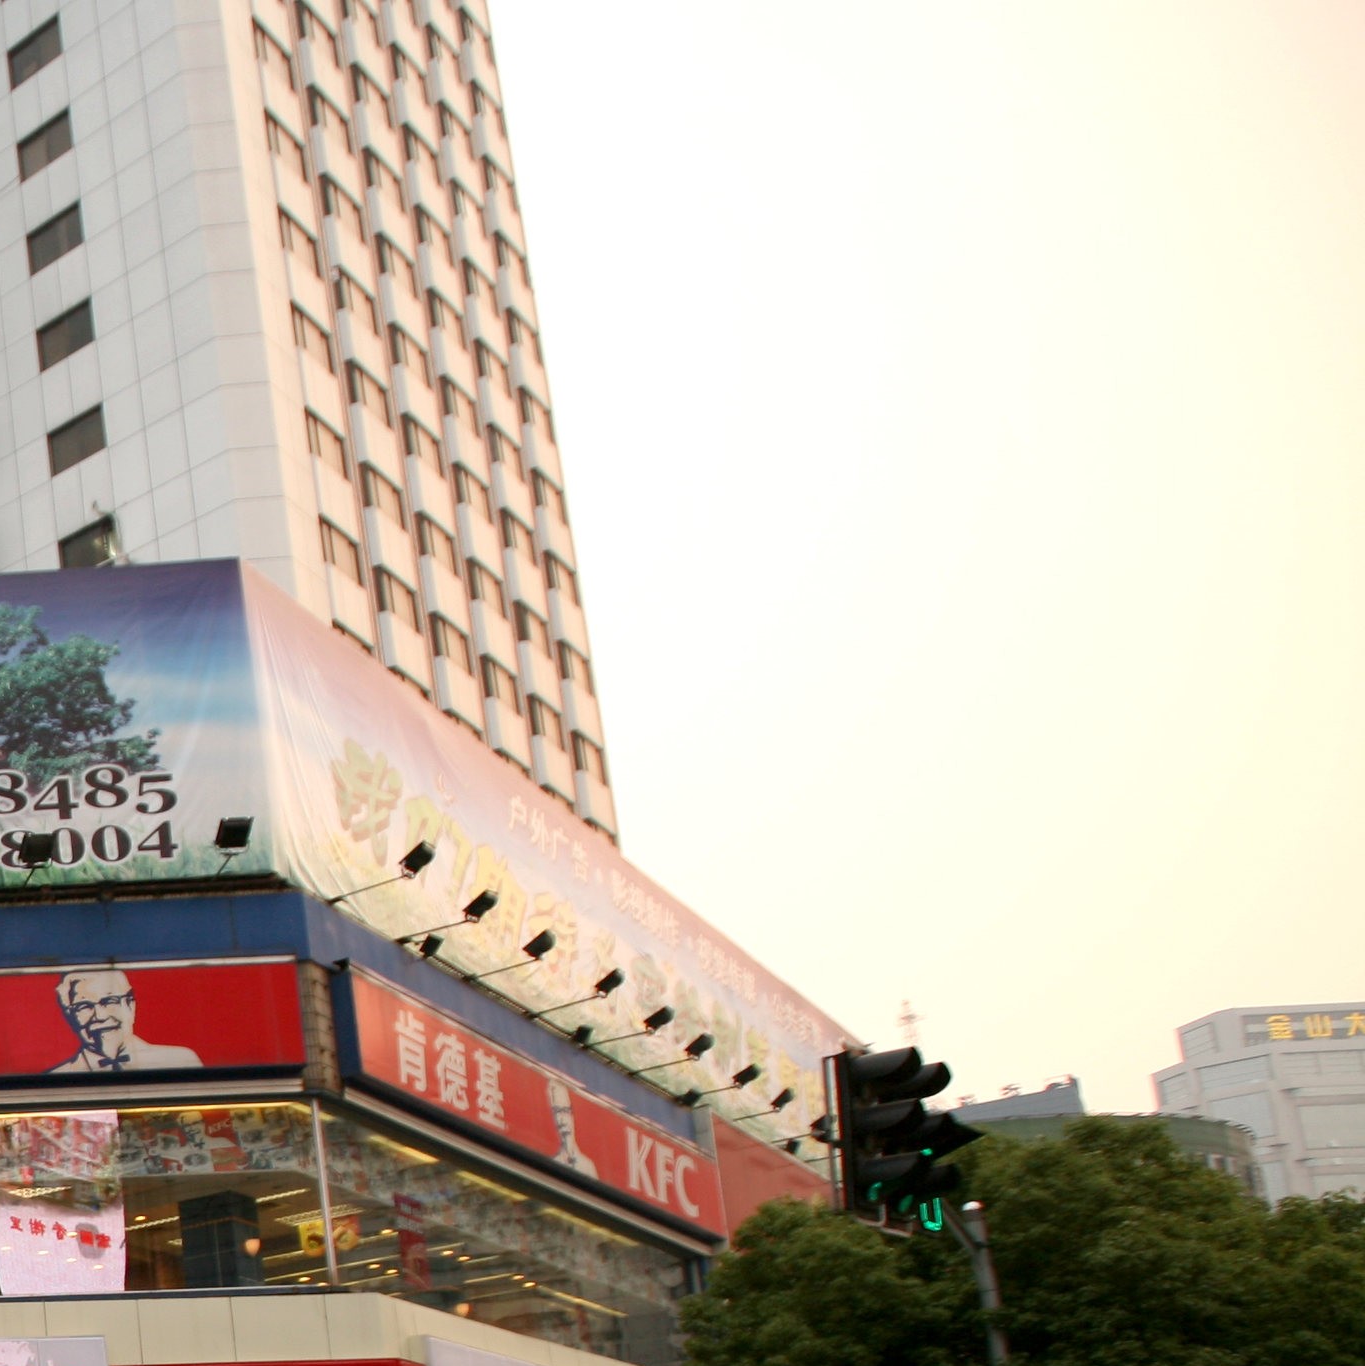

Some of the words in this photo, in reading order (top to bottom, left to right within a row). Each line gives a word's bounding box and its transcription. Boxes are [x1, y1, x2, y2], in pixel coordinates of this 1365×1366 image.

[394, 1010, 506, 1129] 肯德基
[625, 1125, 701, 1219] KFC
